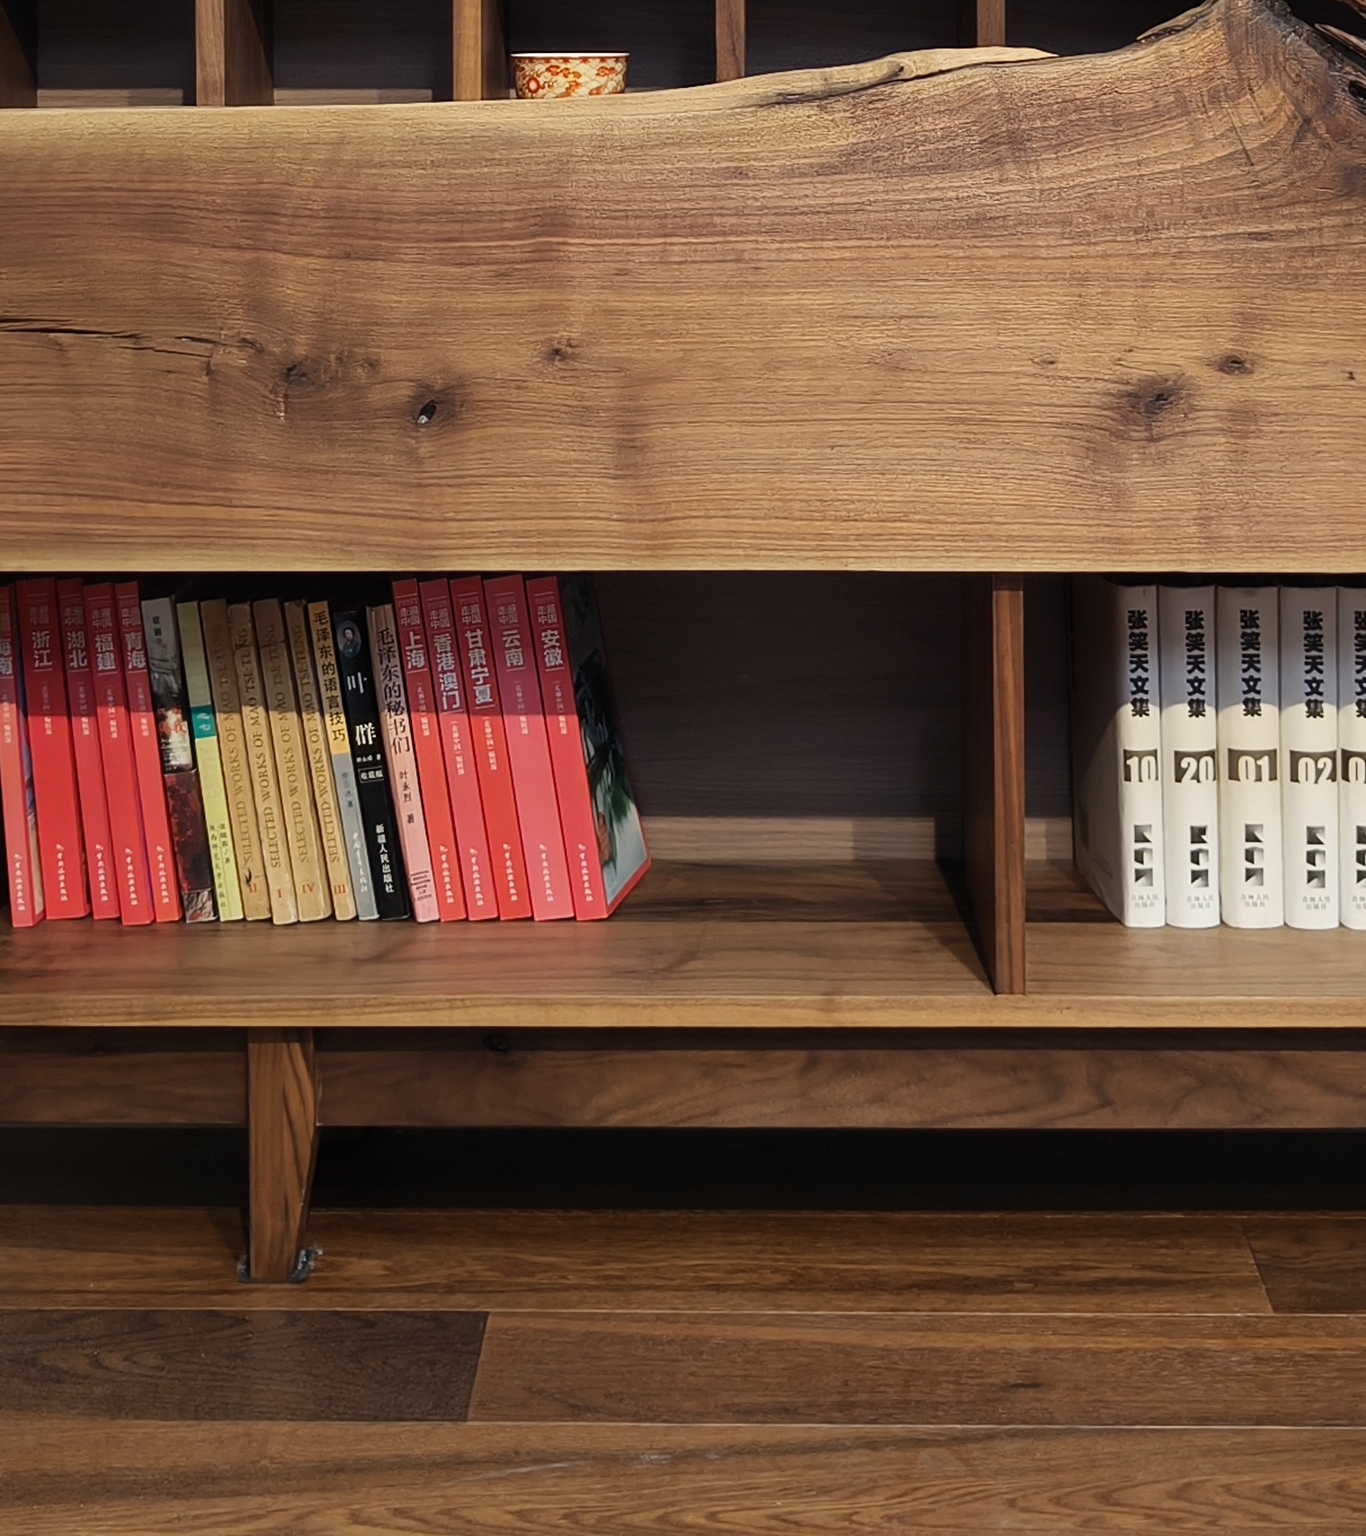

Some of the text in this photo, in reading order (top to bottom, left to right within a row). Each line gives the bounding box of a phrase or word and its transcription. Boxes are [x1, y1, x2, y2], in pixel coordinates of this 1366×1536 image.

[32, 630, 53, 668] 浙江
[67, 631, 88, 668] 湖北
[95, 633, 116, 671] 福建
[125, 632, 146, 669] 青海
[405, 631, 425, 669] 上海
[502, 629, 524, 667] 云南
[541, 630, 563, 668] 安徽
[1128, 610, 1150, 717] 张笑天文集
[1185, 610, 1206, 718] 张笑天文集
[1239, 609, 1262, 717] 张笑天文集
[1303, 610, 1324, 718] 张笑天文集
[313, 610, 346, 742] 毛泽东的语言技巧
[434, 633, 461, 710] 香港澳门
[465, 629, 493, 706] 甘肃宁夏
[220, 692, 234, 721] MAO
[275, 691, 288, 721] MAO
[302, 692, 317, 722] MAO
[377, 628, 411, 755] 毛泽东的秘书们
[248, 697, 261, 726] MAO
[226, 727, 237, 743] OF
[253, 731, 264, 748] OF
[280, 727, 292, 743] OF
[309, 728, 320, 744] OF
[229, 746, 244, 796] WORKS
[256, 752, 272, 803] WORKS
[284, 746, 300, 798] WORKS
[312, 748, 329, 798] WORKS
[399, 770, 412, 803] 叶永烈
[1126, 755, 1157, 782] 10
[1180, 756, 1215, 784] 20
[1238, 755, 1270, 782] 01
[1298, 757, 1333, 784] 02
[237, 800, 254, 866] SELECTED
[263, 806, 281, 868] SELECTED
[291, 801, 309, 863] SELECTED
[320, 801, 340, 863] SELECTED
[376, 824, 394, 894] 新疆人民出版社
